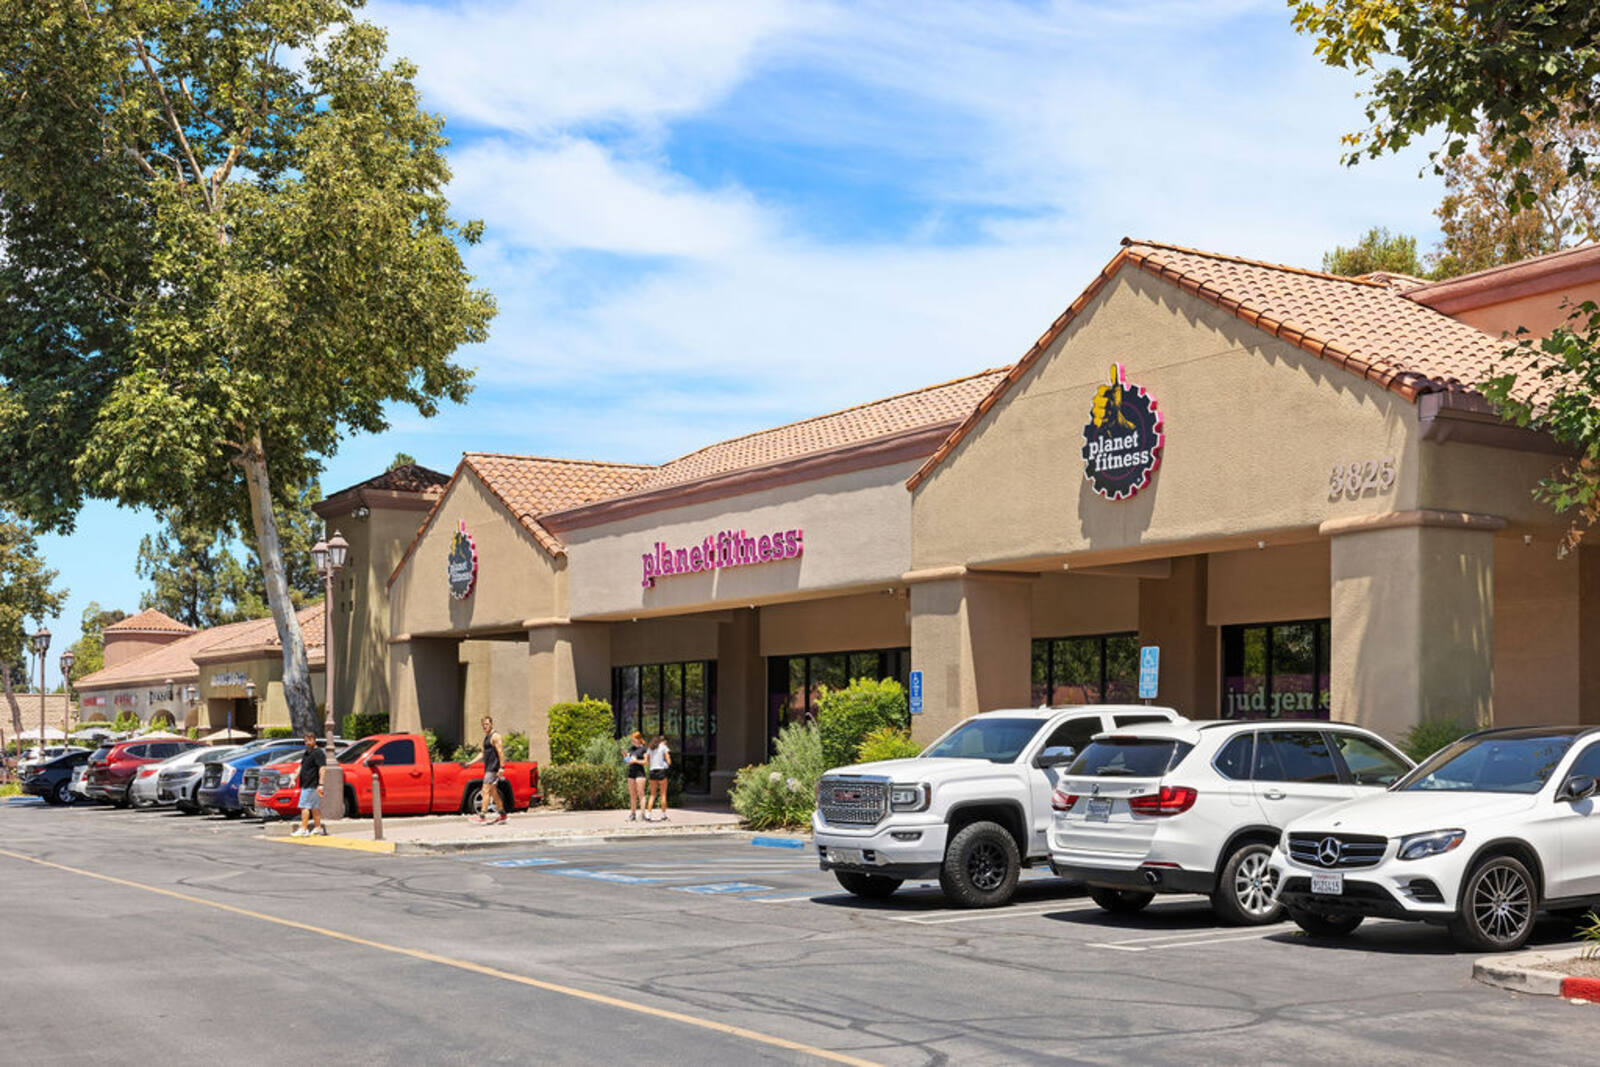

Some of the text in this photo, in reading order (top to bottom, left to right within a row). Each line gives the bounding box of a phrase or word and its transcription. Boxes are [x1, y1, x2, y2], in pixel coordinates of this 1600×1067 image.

[1088, 430, 1139, 460] planet
[1094, 449, 1150, 472] fitness
[1328, 456, 1395, 497] 3825
[641, 529, 803, 588] planet fitness
